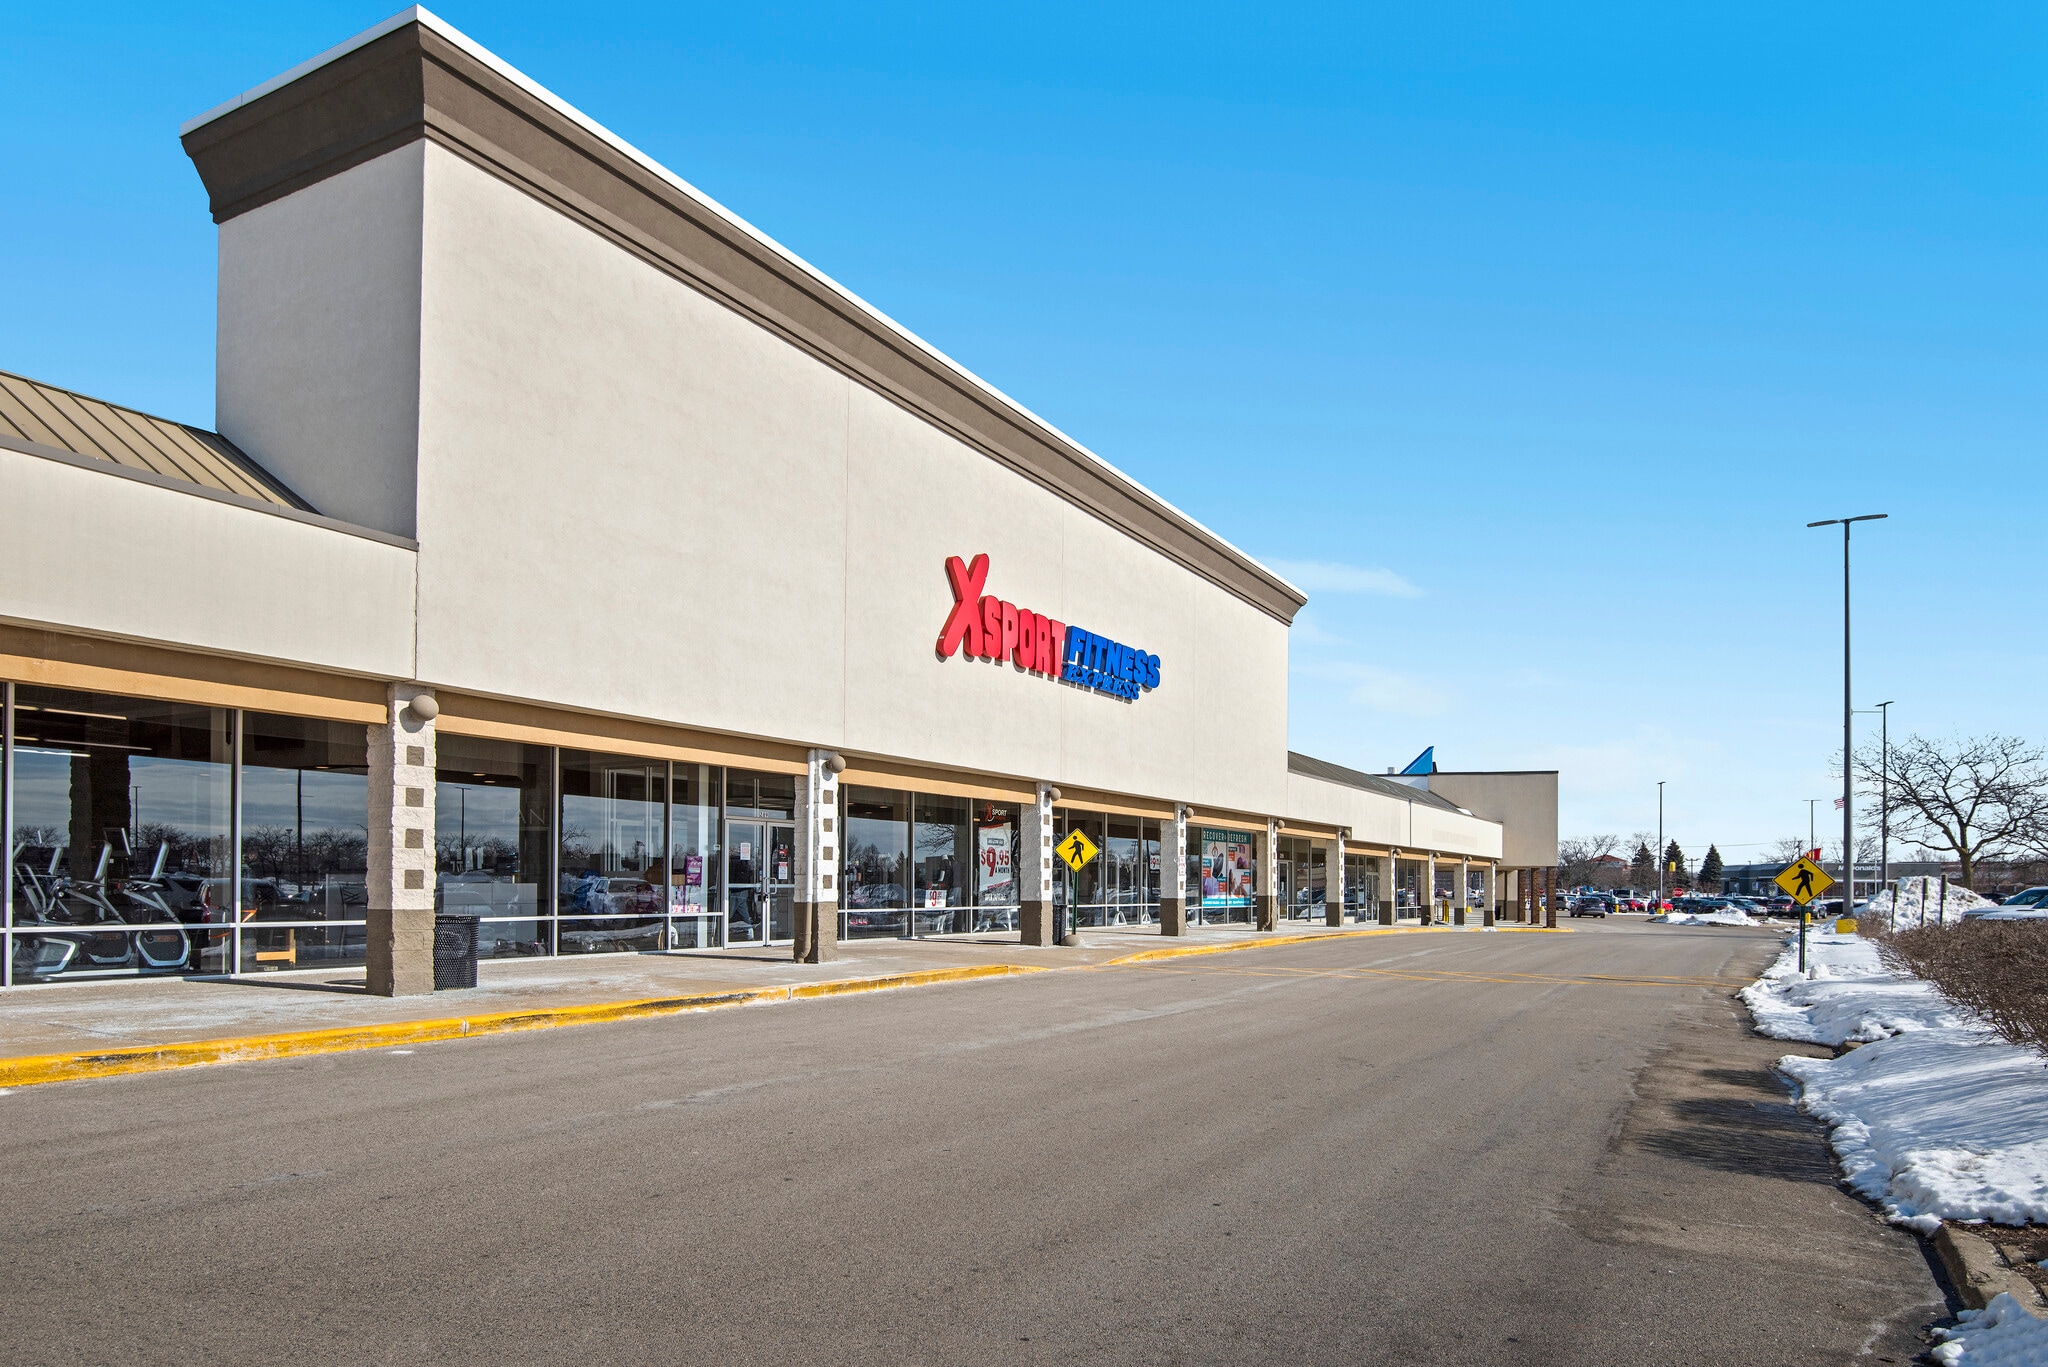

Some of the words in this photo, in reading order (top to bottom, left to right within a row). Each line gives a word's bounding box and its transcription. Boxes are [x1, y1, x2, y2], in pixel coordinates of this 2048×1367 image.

[1065, 625, 1161, 689] FITNESS
[1063, 664, 1141, 701] EXPRESS
[981, 846, 1009, 877] $9.95
